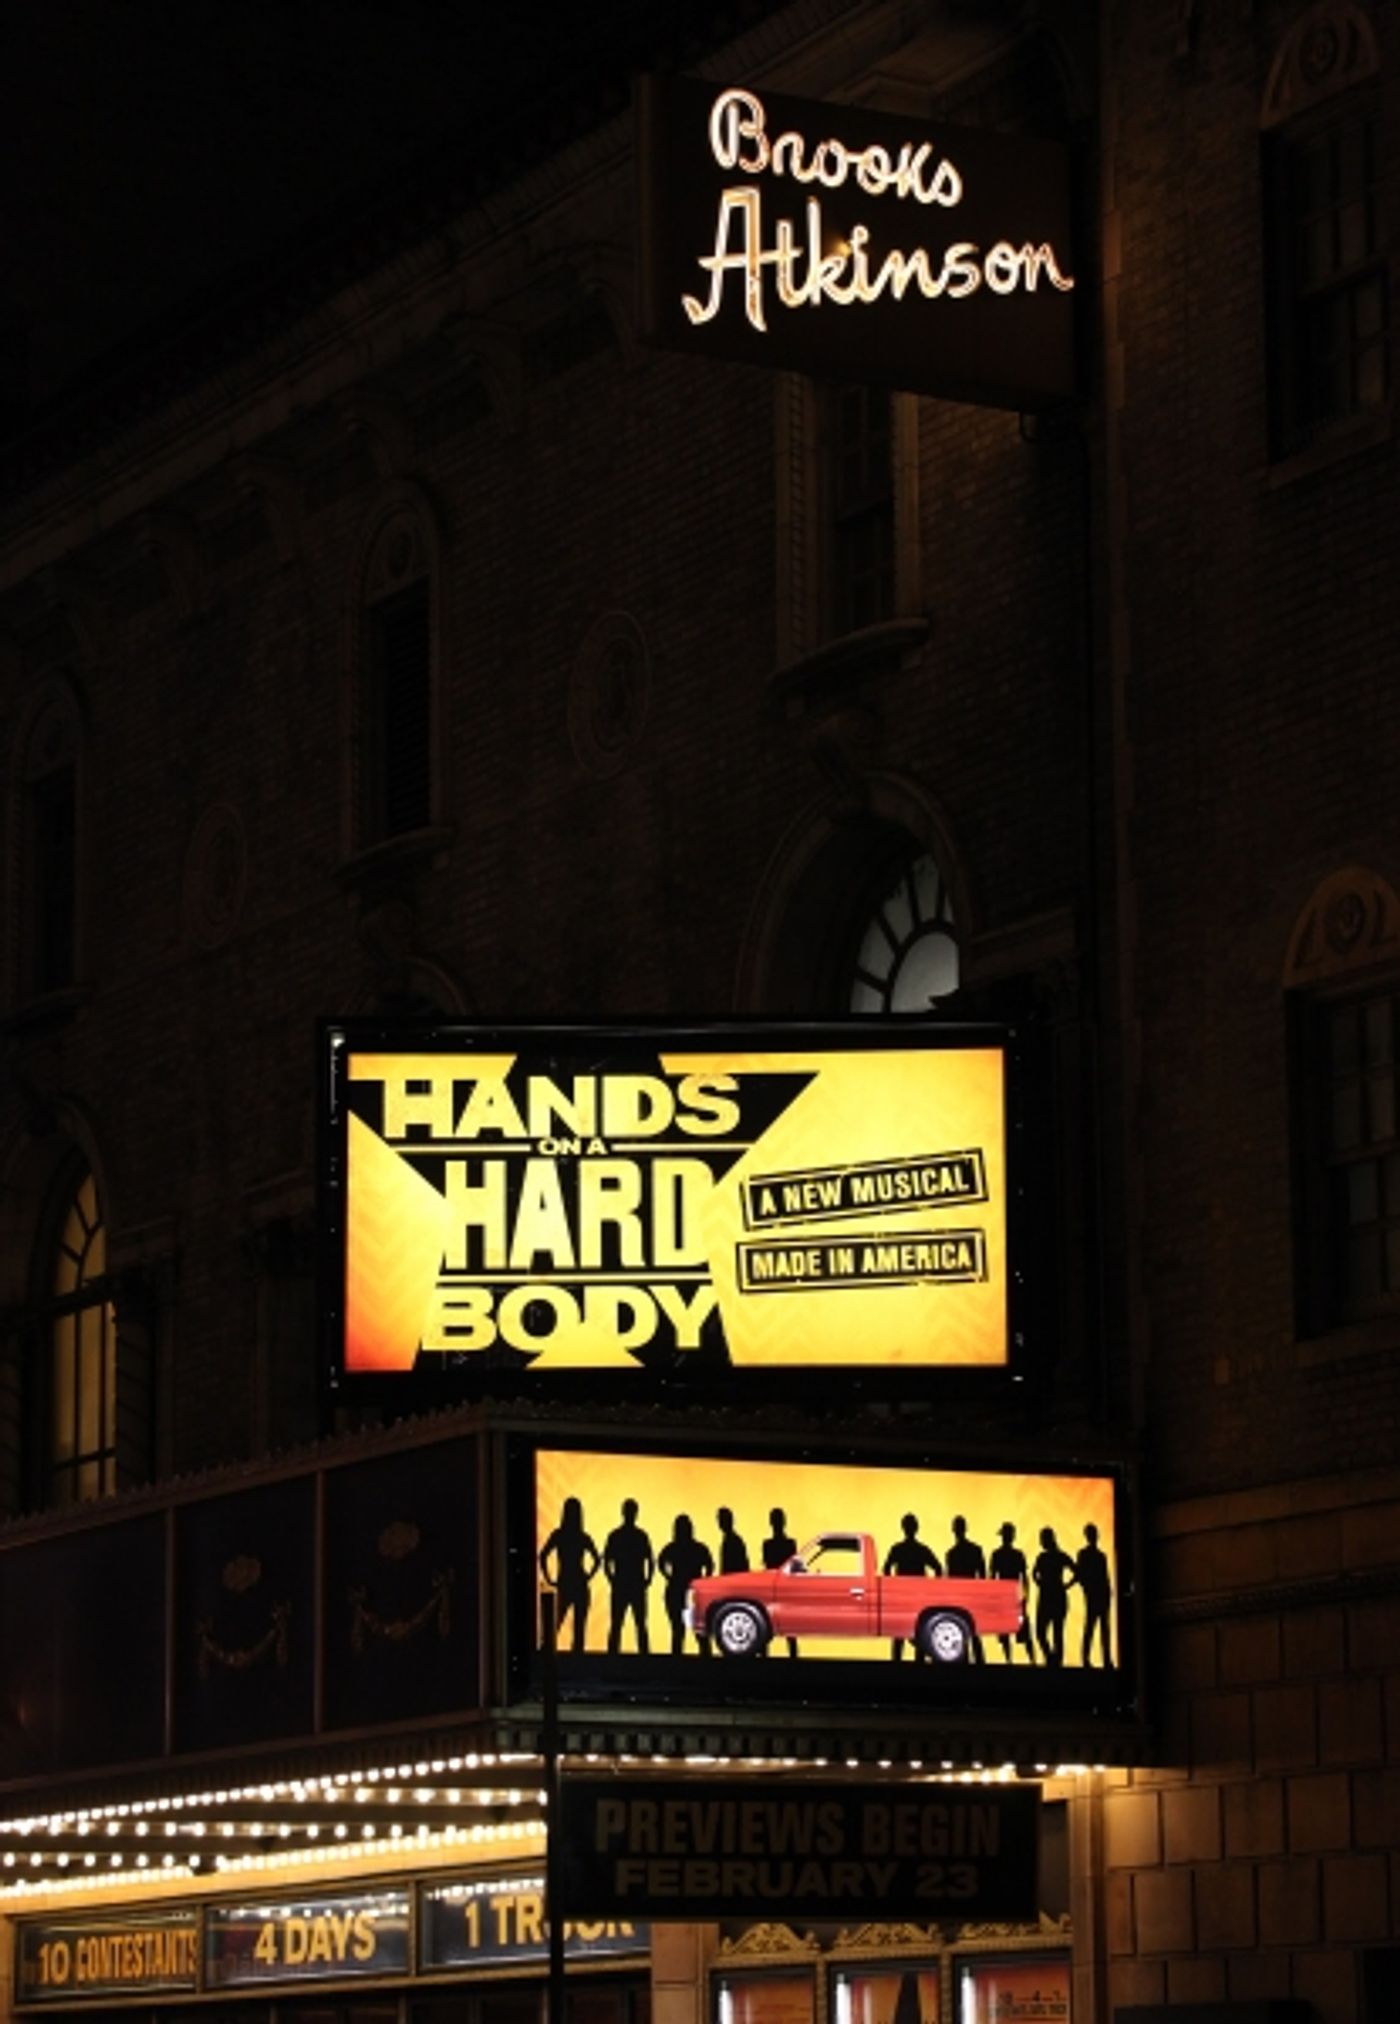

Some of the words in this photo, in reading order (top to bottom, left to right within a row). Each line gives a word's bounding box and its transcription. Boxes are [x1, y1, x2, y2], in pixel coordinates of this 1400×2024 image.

[709, 88, 963, 207] Brooks
[681, 185, 1074, 333] Atkinson
[383, 1074, 741, 1138] HANDS
[537, 1137, 581, 1156] ON
[585, 1137, 608, 1155] A
[443, 1158, 716, 1270] HARD
[759, 1187, 777, 1217] A
[782, 1178, 844, 1213] NEW
[850, 1163, 970, 1205] MUSICAL
[752, 1251, 822, 1280] MADE
[829, 1247, 855, 1274] IN
[861, 1242, 973, 1274] AMERICA
[421, 1285, 720, 1352] BODY
[594, 1799, 848, 1855] PREVIEWS
[861, 1803, 1000, 1857] BEGIN
[613, 1858, 900, 1899] FEBRUARY
[911, 1863, 980, 1899] 23
[254, 1923, 278, 1965] 4
[284, 1911, 377, 1966] DAYS
[464, 1901, 481, 1948] 1
[38, 1940, 70, 1985] 10
